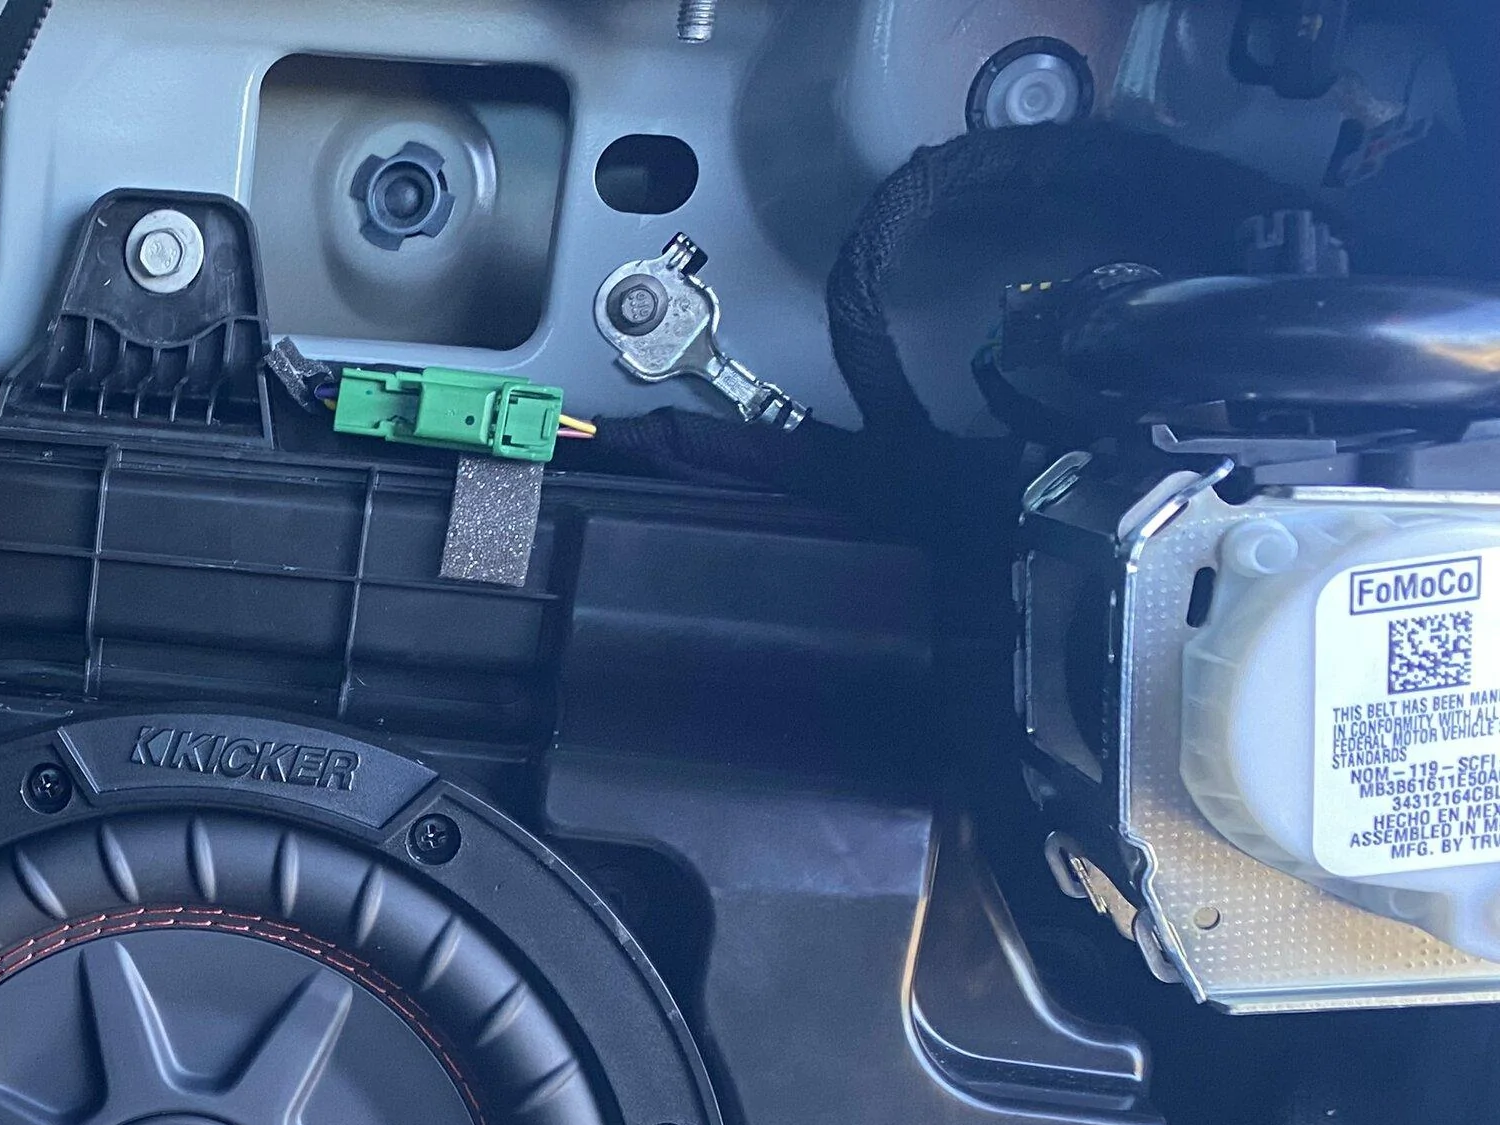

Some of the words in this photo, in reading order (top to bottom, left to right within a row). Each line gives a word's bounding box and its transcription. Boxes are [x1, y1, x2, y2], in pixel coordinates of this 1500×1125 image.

[1358, 568, 1473, 606] FoMoCo
[1333, 705, 1362, 723] THIS
[1367, 701, 1397, 719] BELT
[1402, 697, 1428, 715] HAS
[1433, 693, 1464, 711] BEEN
[1470, 689, 1500, 706] MAN
[1333, 724, 1346, 740] IN
[1350, 713, 1434, 737] CONFORMITY
[1439, 709, 1471, 727] WITH
[1476, 706, 1499, 722] ALL
[1333, 734, 1387, 754] FEDERAL
[1393, 728, 1437, 747] MOTOR
[1441, 721, 1495, 740] VEHICLE
[170, 731, 360, 791] KICKER
[1332, 746, 1407, 769] STANDARDS
[1360, 769, 1500, 798] MB3B61611E50A
[1350, 823, 1451, 848] ASSEMBLED
[1460, 820, 1476, 835] IN
[1484, 818, 1500, 833] M
[1374, 810, 1430, 830] HECHO
[1438, 807, 1459, 823] EN
[1391, 841, 1434, 859] MFG.
[1442, 837, 1463, 853] BY
